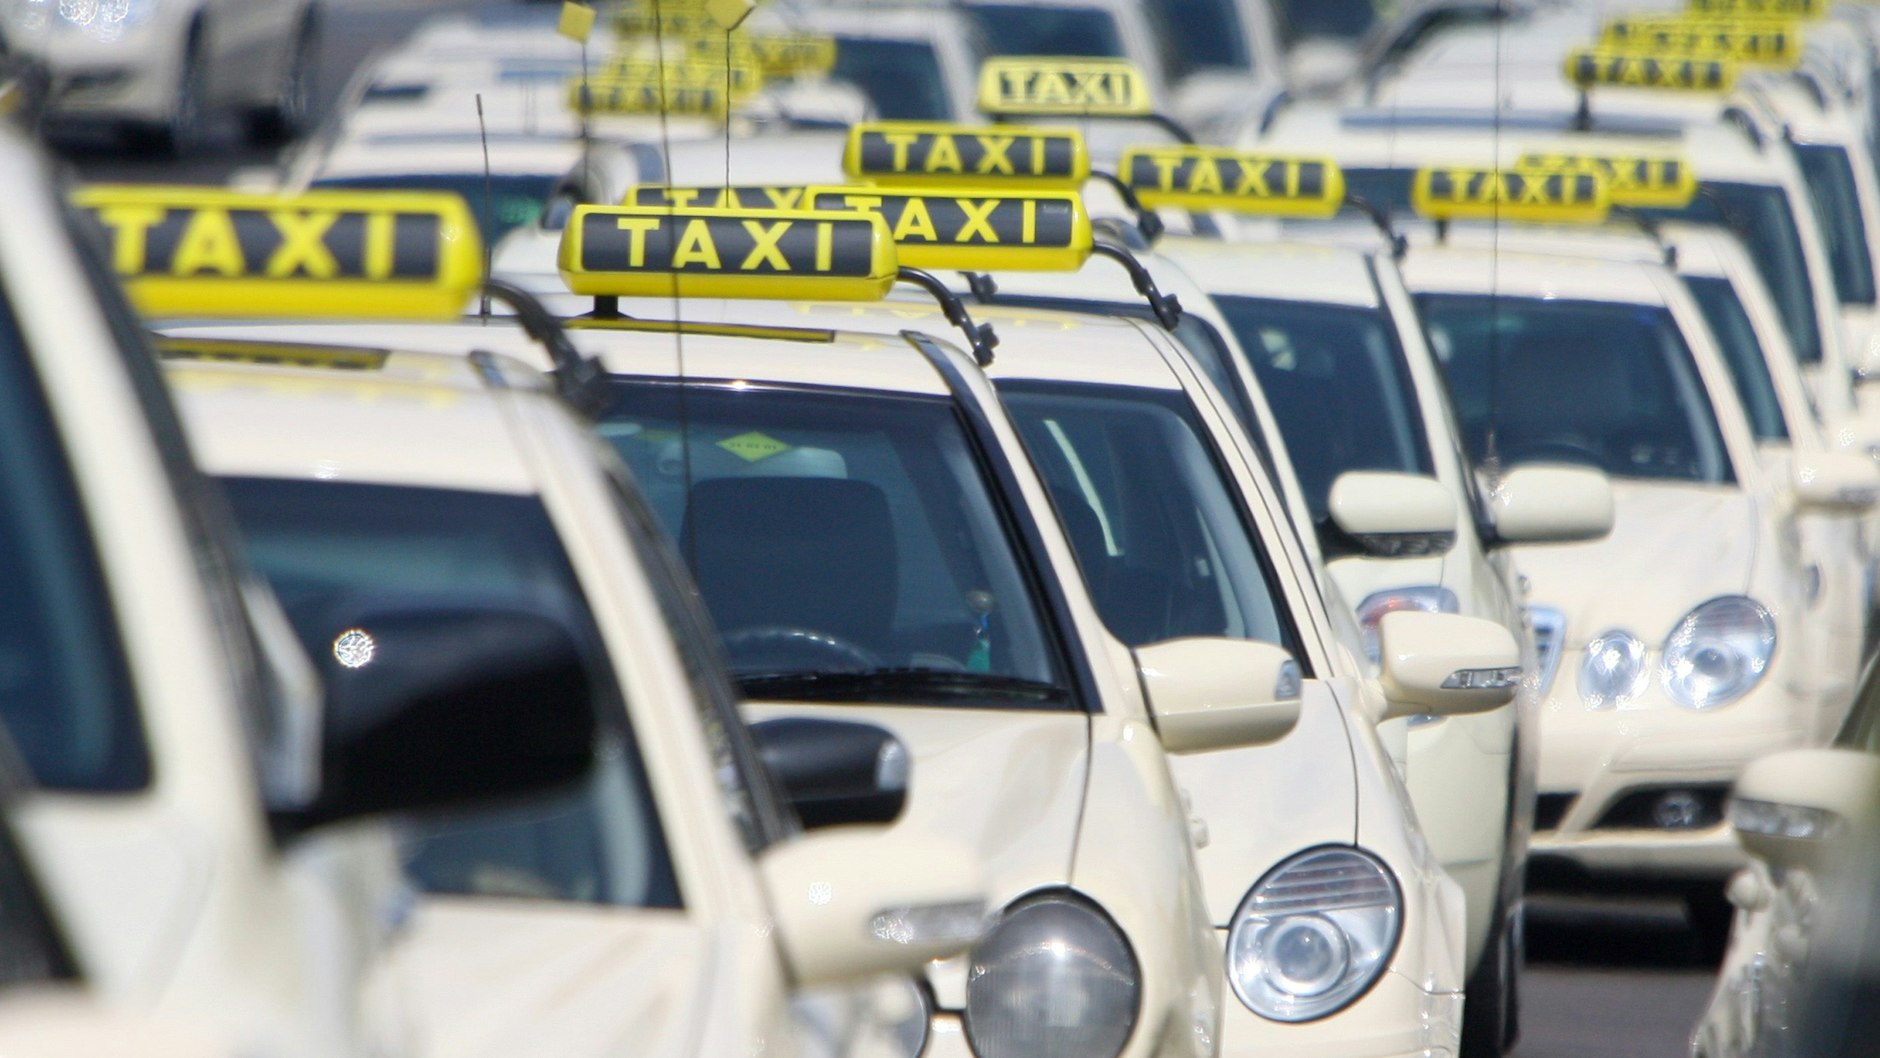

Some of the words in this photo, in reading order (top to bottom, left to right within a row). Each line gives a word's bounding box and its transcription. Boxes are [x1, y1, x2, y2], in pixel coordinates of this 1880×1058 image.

[1003, 71, 1125, 105] TAXI
[884, 134, 1045, 174] TAXI
[1152, 157, 1300, 196] TAXI
[1447, 173, 1575, 205] TAXI
[100, 206, 396, 278] TAXI
[617, 217, 832, 271] TAXI
